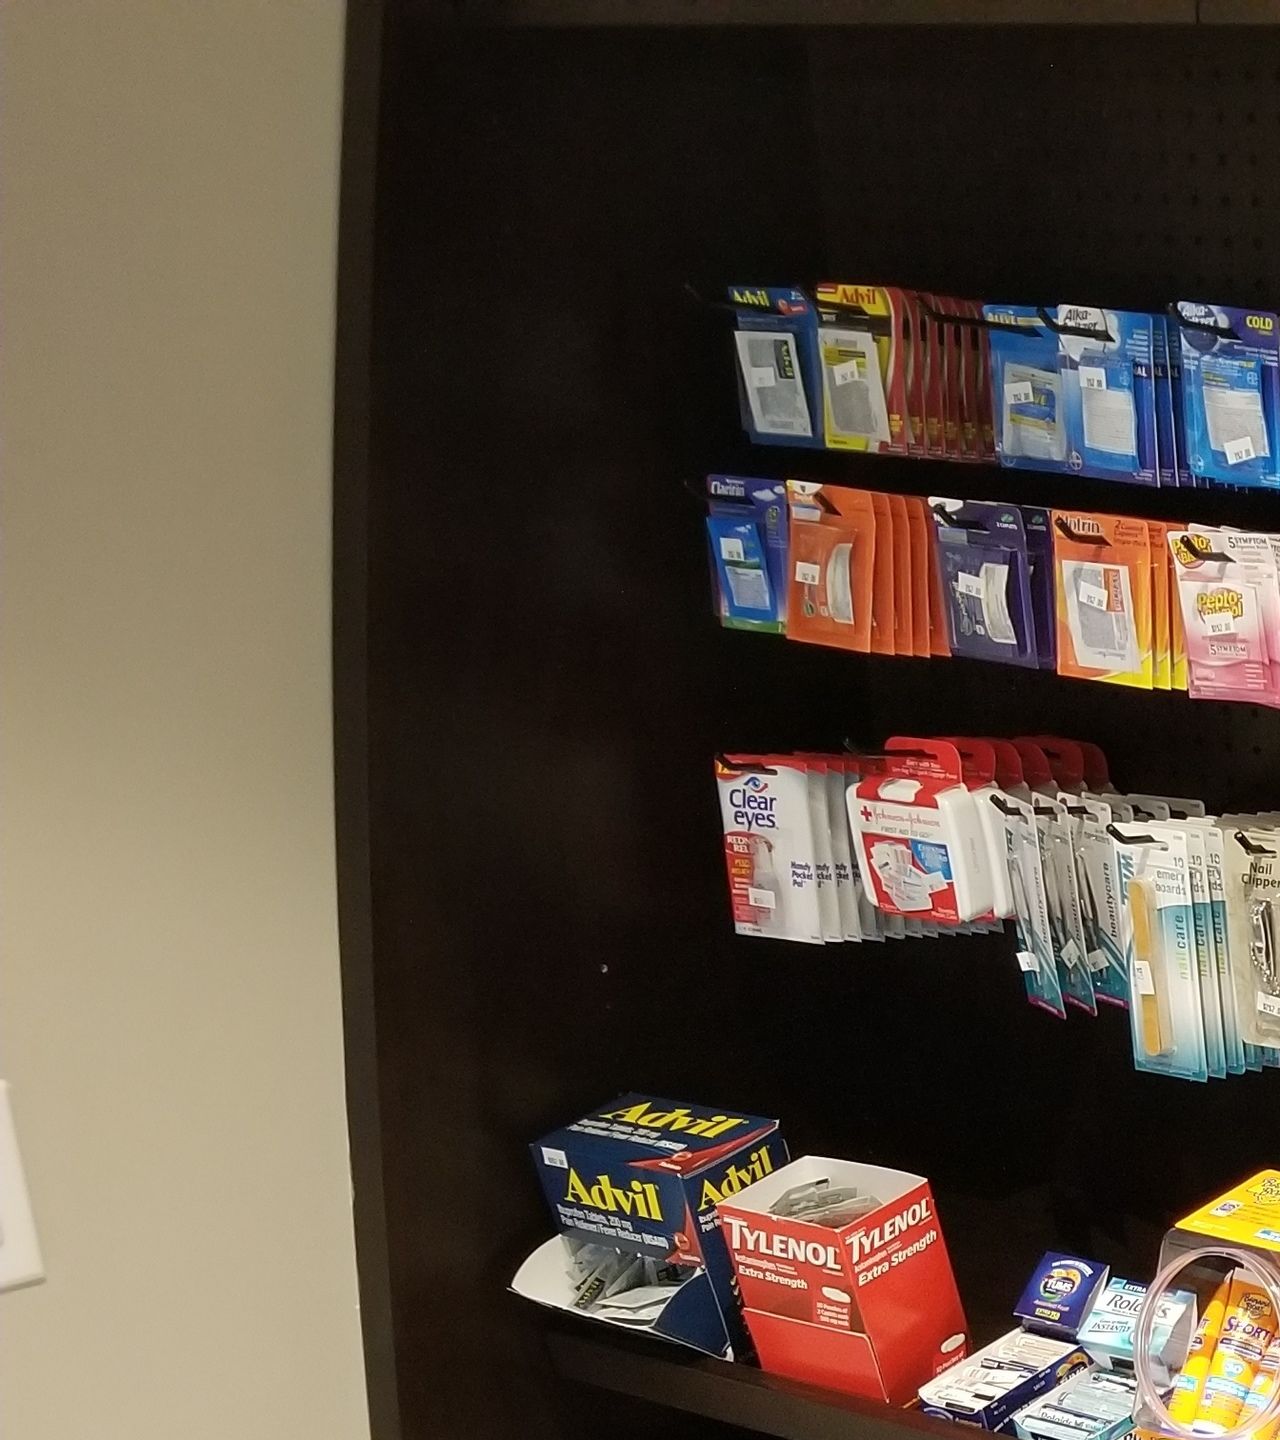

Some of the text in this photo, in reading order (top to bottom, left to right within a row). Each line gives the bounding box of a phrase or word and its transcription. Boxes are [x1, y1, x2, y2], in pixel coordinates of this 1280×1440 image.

[840, 287, 877, 305] Advil
[1246, 315, 1273, 331] COLD
[729, 788, 777, 812] Clear
[734, 811, 776, 831] eyes
[791, 870, 813, 882] Pocket
[1250, 862, 1272, 875] Nail
[598, 1101, 744, 1138] Advil
[698, 1146, 774, 1212] Advil
[564, 1168, 663, 1221] Advil
[723, 1217, 842, 1270] TYLENOL
[845, 1198, 931, 1265] TYLENOL
[858, 1261, 890, 1287] Extra
[891, 1230, 937, 1267] Strength
[738, 1265, 808, 1290] Extra Strength
[1046, 1279, 1074, 1294] TUMS
[1222, 1315, 1271, 1342] SPORT
